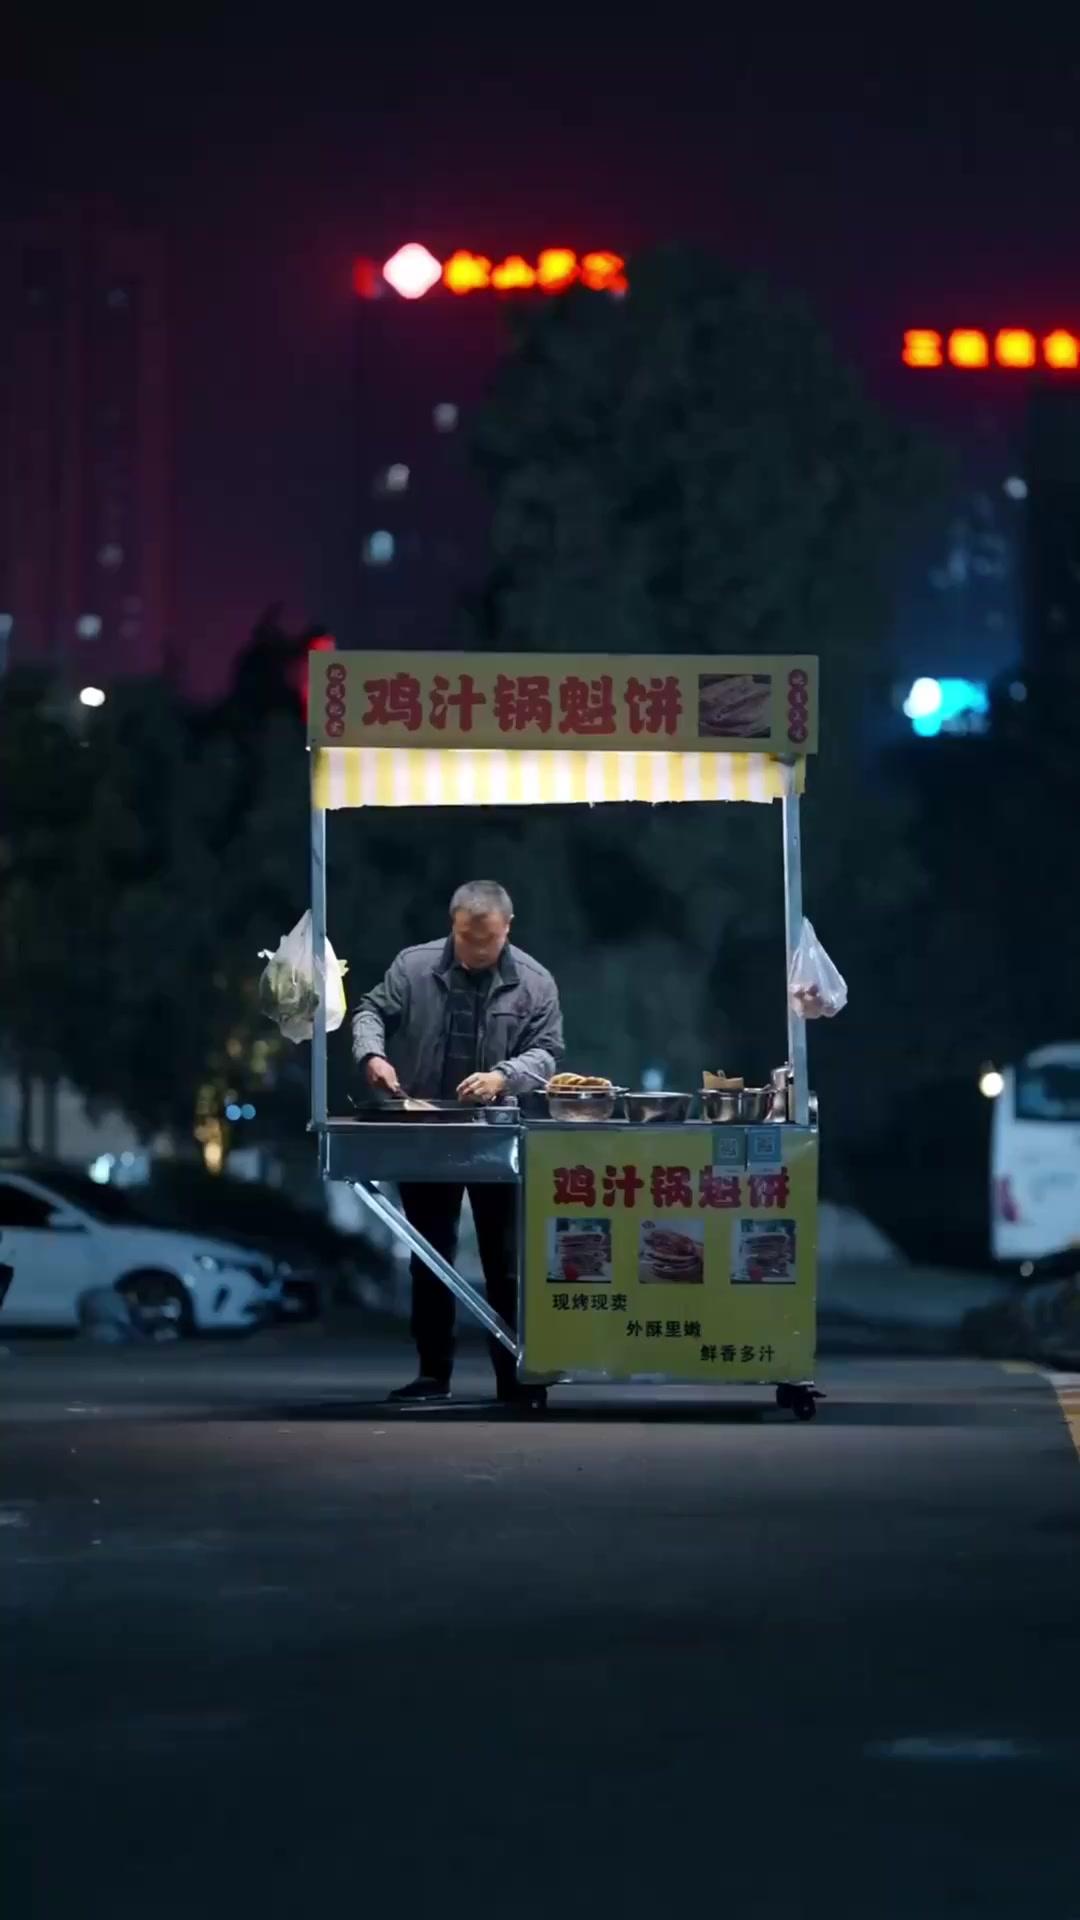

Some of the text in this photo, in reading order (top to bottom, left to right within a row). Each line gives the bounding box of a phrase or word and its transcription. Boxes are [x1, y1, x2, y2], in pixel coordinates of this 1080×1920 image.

[362, 672, 682, 735] 鸡汁锅魁饼
[552, 1294, 627, 1311] 现烤现卖
[626, 1320, 702, 1338] 外酥里嫩
[700, 1345, 775, 1363] 鲜香多汁
